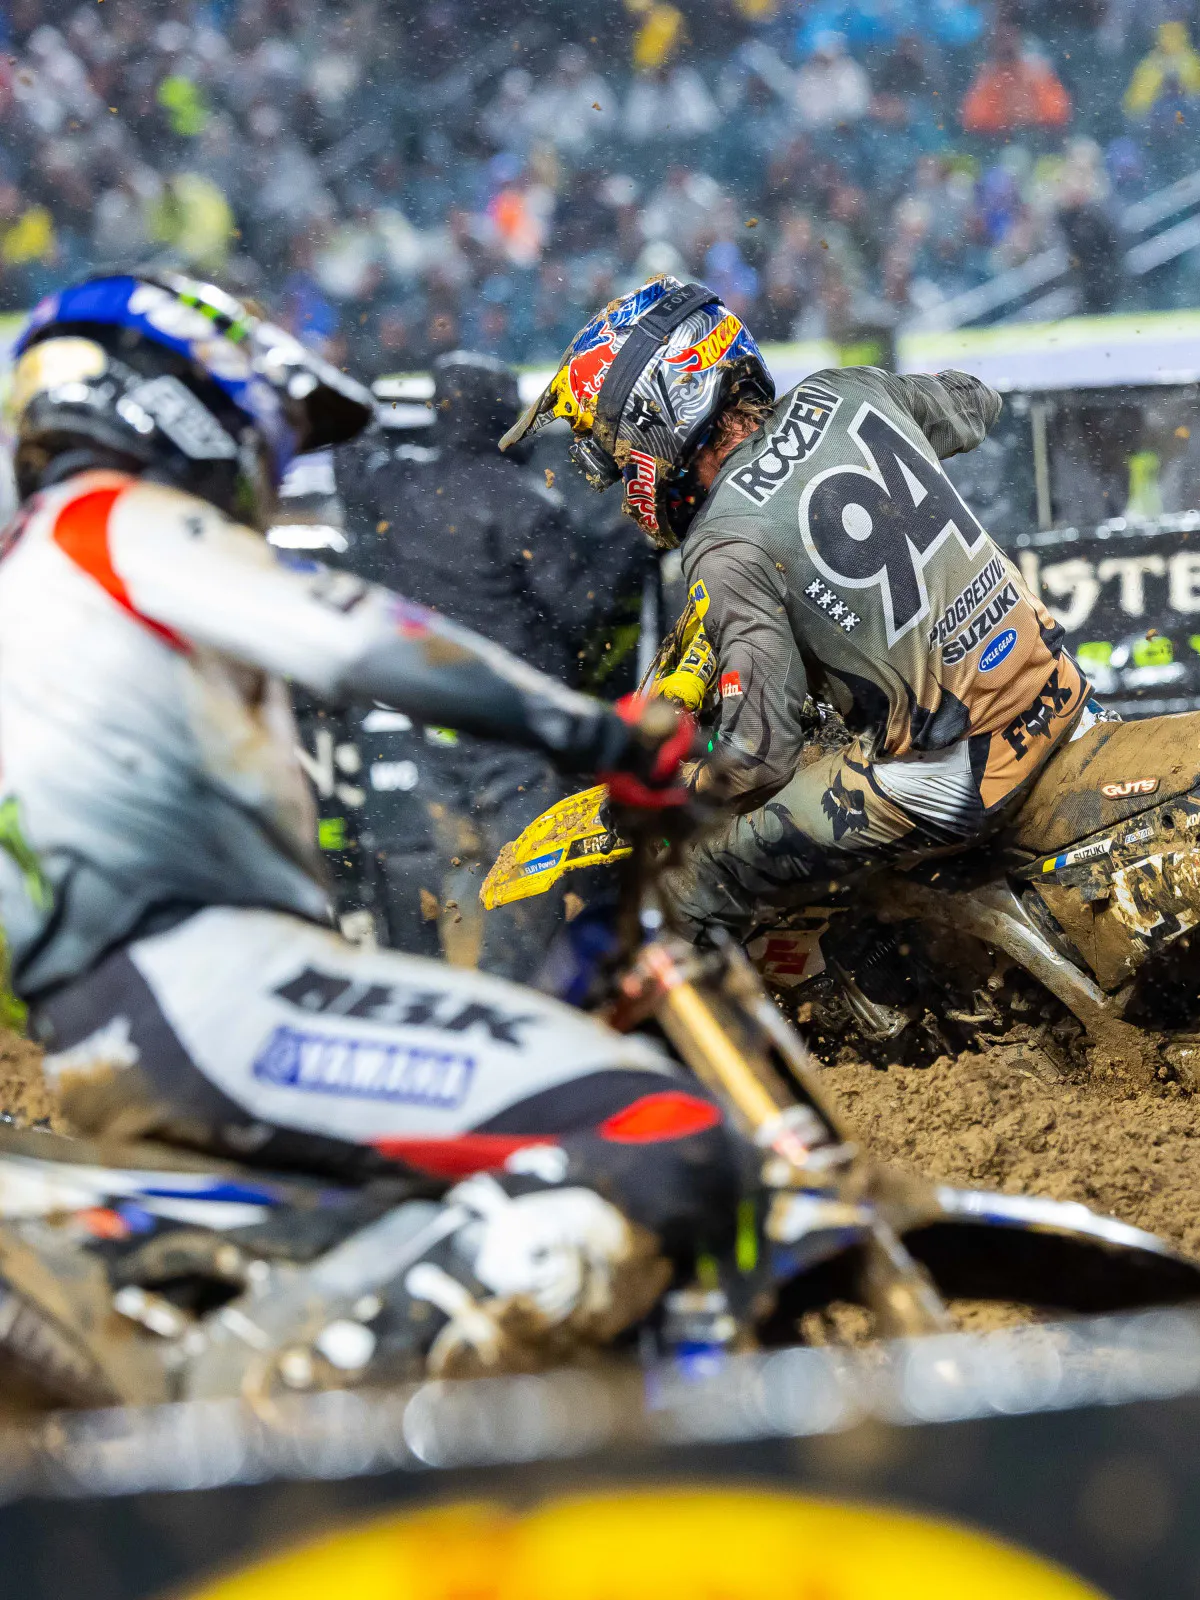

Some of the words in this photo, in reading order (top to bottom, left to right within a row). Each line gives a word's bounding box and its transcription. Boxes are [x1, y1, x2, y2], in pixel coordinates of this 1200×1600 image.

[662, 291, 690, 311] FOX
[728, 385, 842, 505] ROCZEN
[626, 447, 657, 502] Bull
[801, 403, 986, 646] 94
[943, 581, 1020, 665] SUZUKI
[980, 646, 1000, 669] CYCLE
[998, 632, 1015, 653] GEAR
[1102, 779, 1156, 797] GUTS
[538, 858, 556, 870] Power
[1073, 845, 1106, 862] SUZUKI
